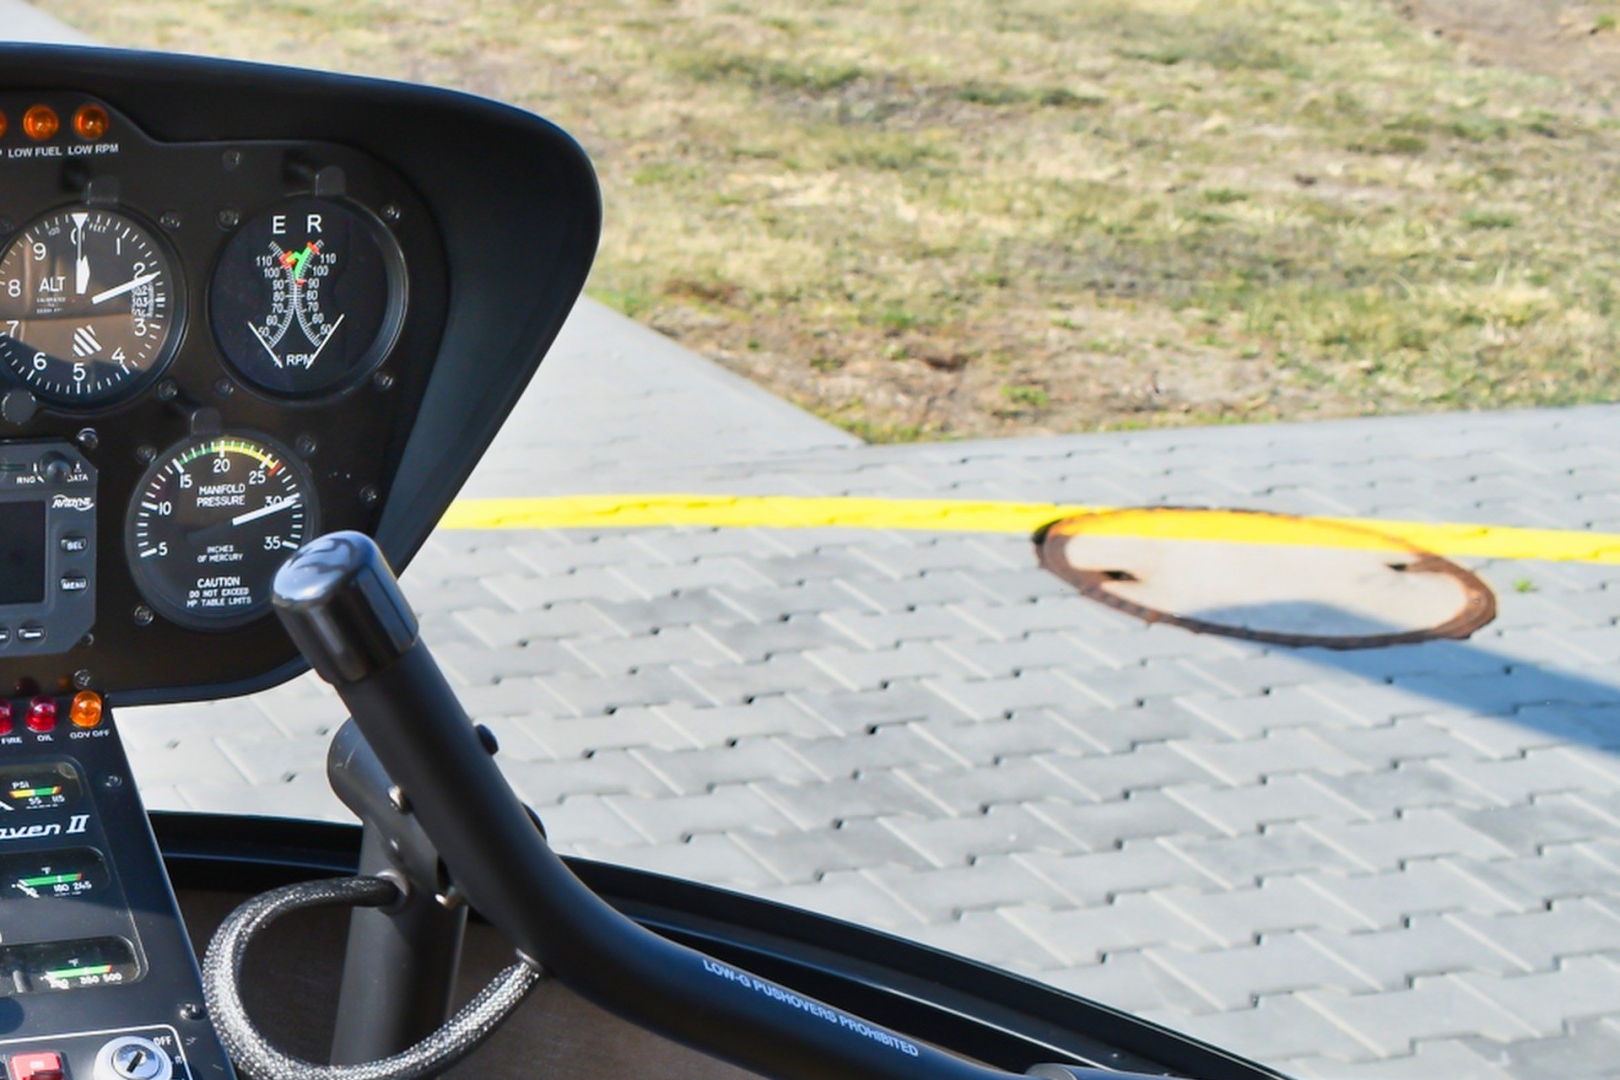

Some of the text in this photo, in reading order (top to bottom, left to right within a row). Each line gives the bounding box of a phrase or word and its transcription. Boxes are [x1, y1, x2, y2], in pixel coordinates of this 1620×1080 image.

[8, 147, 62, 158] LOW FUEL
[68, 144, 119, 155] LOW RPM
[273, 214, 322, 233] E R
[33, 243, 46, 260] 9
[8, 279, 21, 297] 8
[39, 277, 66, 292] ALT
[33, 353, 47, 370] 6
[73, 363, 85, 381] 5
[213, 459, 230, 473] 20
[17, 476, 35, 484] RNG
[180, 476, 192, 488] 15
[249, 472, 265, 484] 25
[199, 484, 246, 495] MANIFOLD
[197, 496, 245, 507] PRESSURE
[67, 541, 82, 550] SEL
[209, 553, 243, 562] MERCURY
[62, 581, 86, 589] MENU
[197, 577, 240, 588] CAUTION
[202, 589, 217, 597] NOT
[221, 588, 249, 596] EXCEED
[2, 736, 22, 744] FIRE
[37, 734, 53, 742] OIL
[70, 730, 110, 739] GOV OFF
[66, 814, 90, 834] II
[702, 959, 919, 1057] LOW-G PUSHOVERS PROHIBITED
